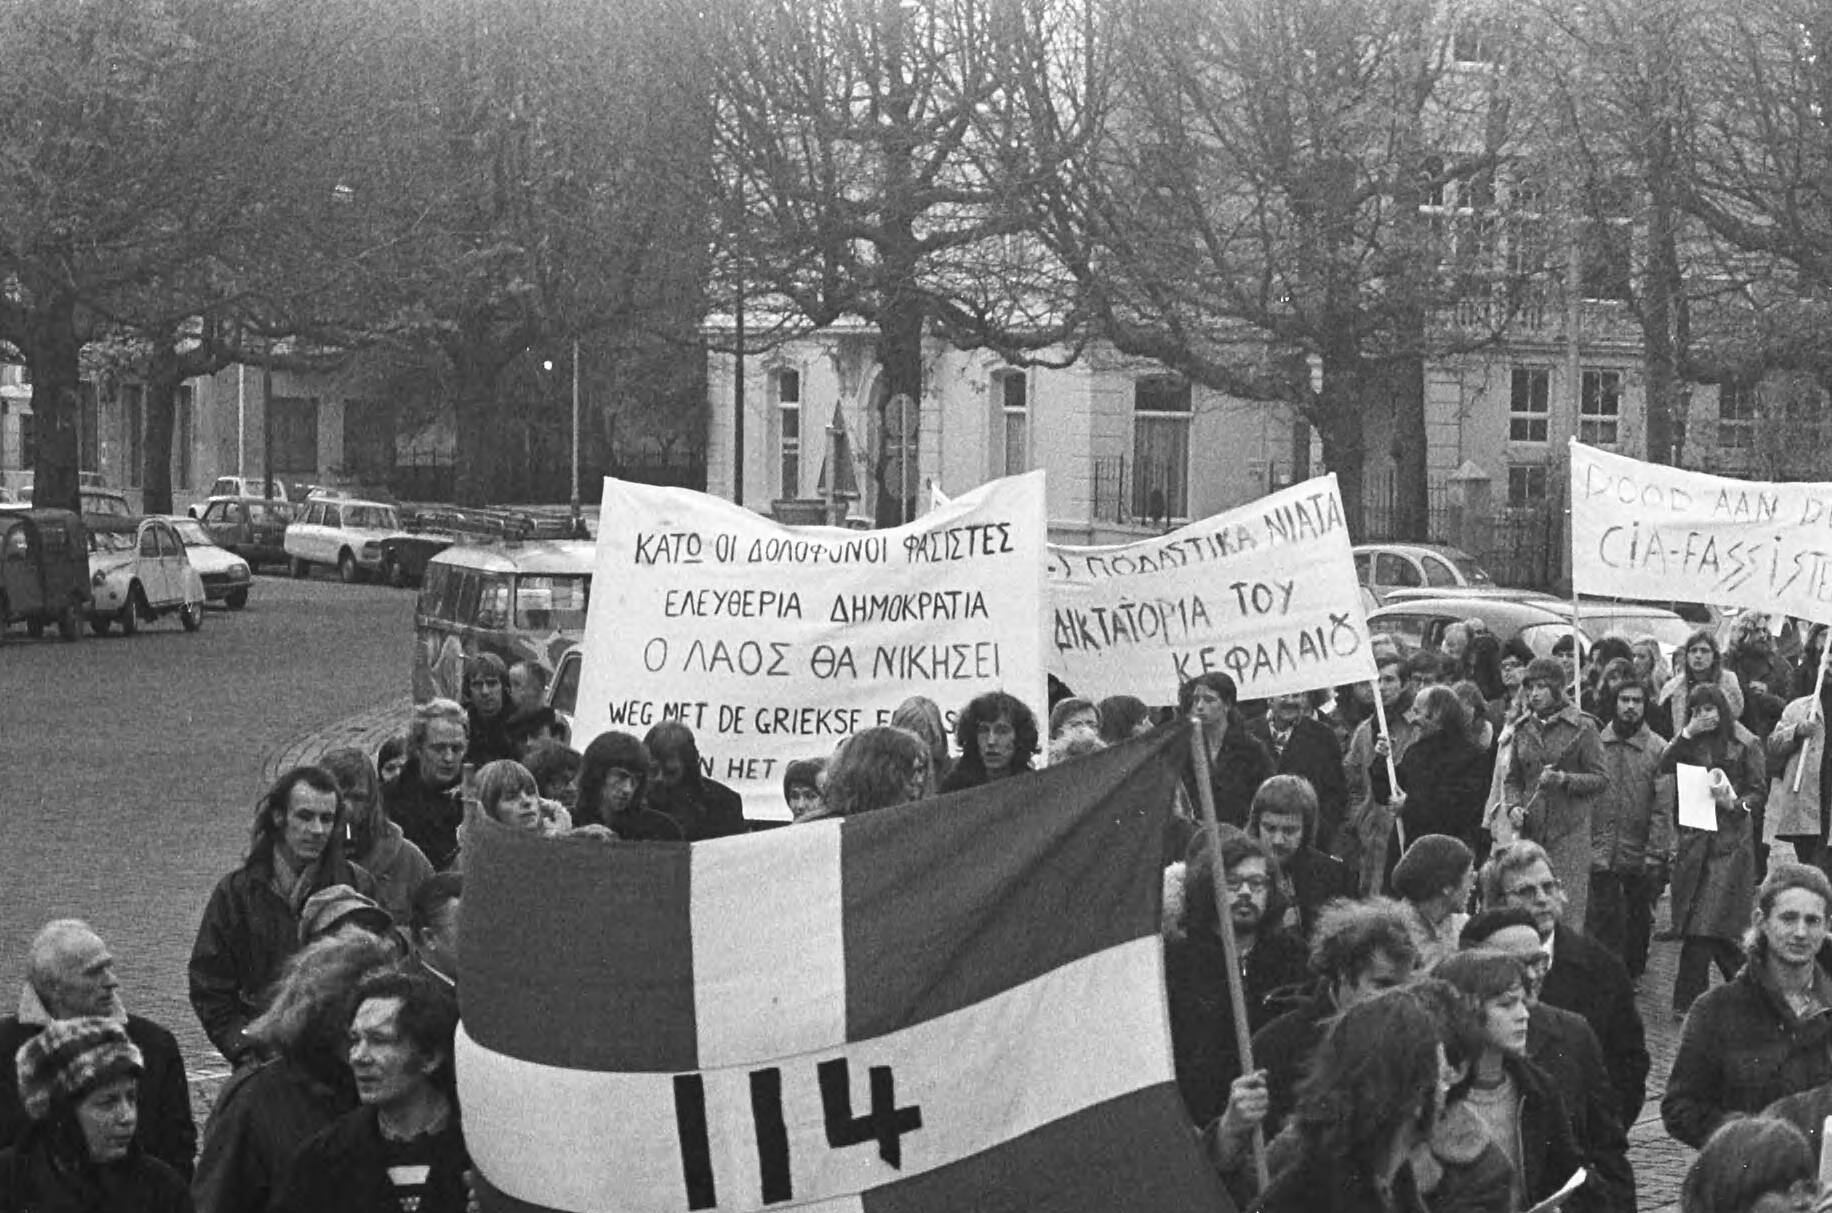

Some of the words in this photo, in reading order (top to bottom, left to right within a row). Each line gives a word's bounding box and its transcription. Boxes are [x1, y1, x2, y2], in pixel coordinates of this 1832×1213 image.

[1585, 463, 1693, 512] DOOD
[1711, 488, 1778, 522] AAN
[715, 533, 737, 563] ΟΙ
[903, 522, 1014, 563] ΦΑΣΙΣΤΕΣ
[665, 589, 802, 619] ΕΛΕΥΘΕΡΙΑ
[830, 590, 989, 622] ΔΗΜΟΚΡΑΤΙΑ
[1229, 580, 1294, 616] ΤΟΥ
[644, 637, 668, 672] Ο
[683, 639, 792, 676] ΛΑΟΣ
[811, 644, 857, 679] ΘΑ
[873, 642, 1001, 680] ΝΙΚΗΣΕΙ
[609, 700, 653, 726] WEG
[662, 702, 709, 729] MET
[718, 704, 746, 734] DE
[755, 707, 862, 735] GRIEKSE
[727, 757, 778, 779] HET
[673, 1056, 923, 1212] 114
